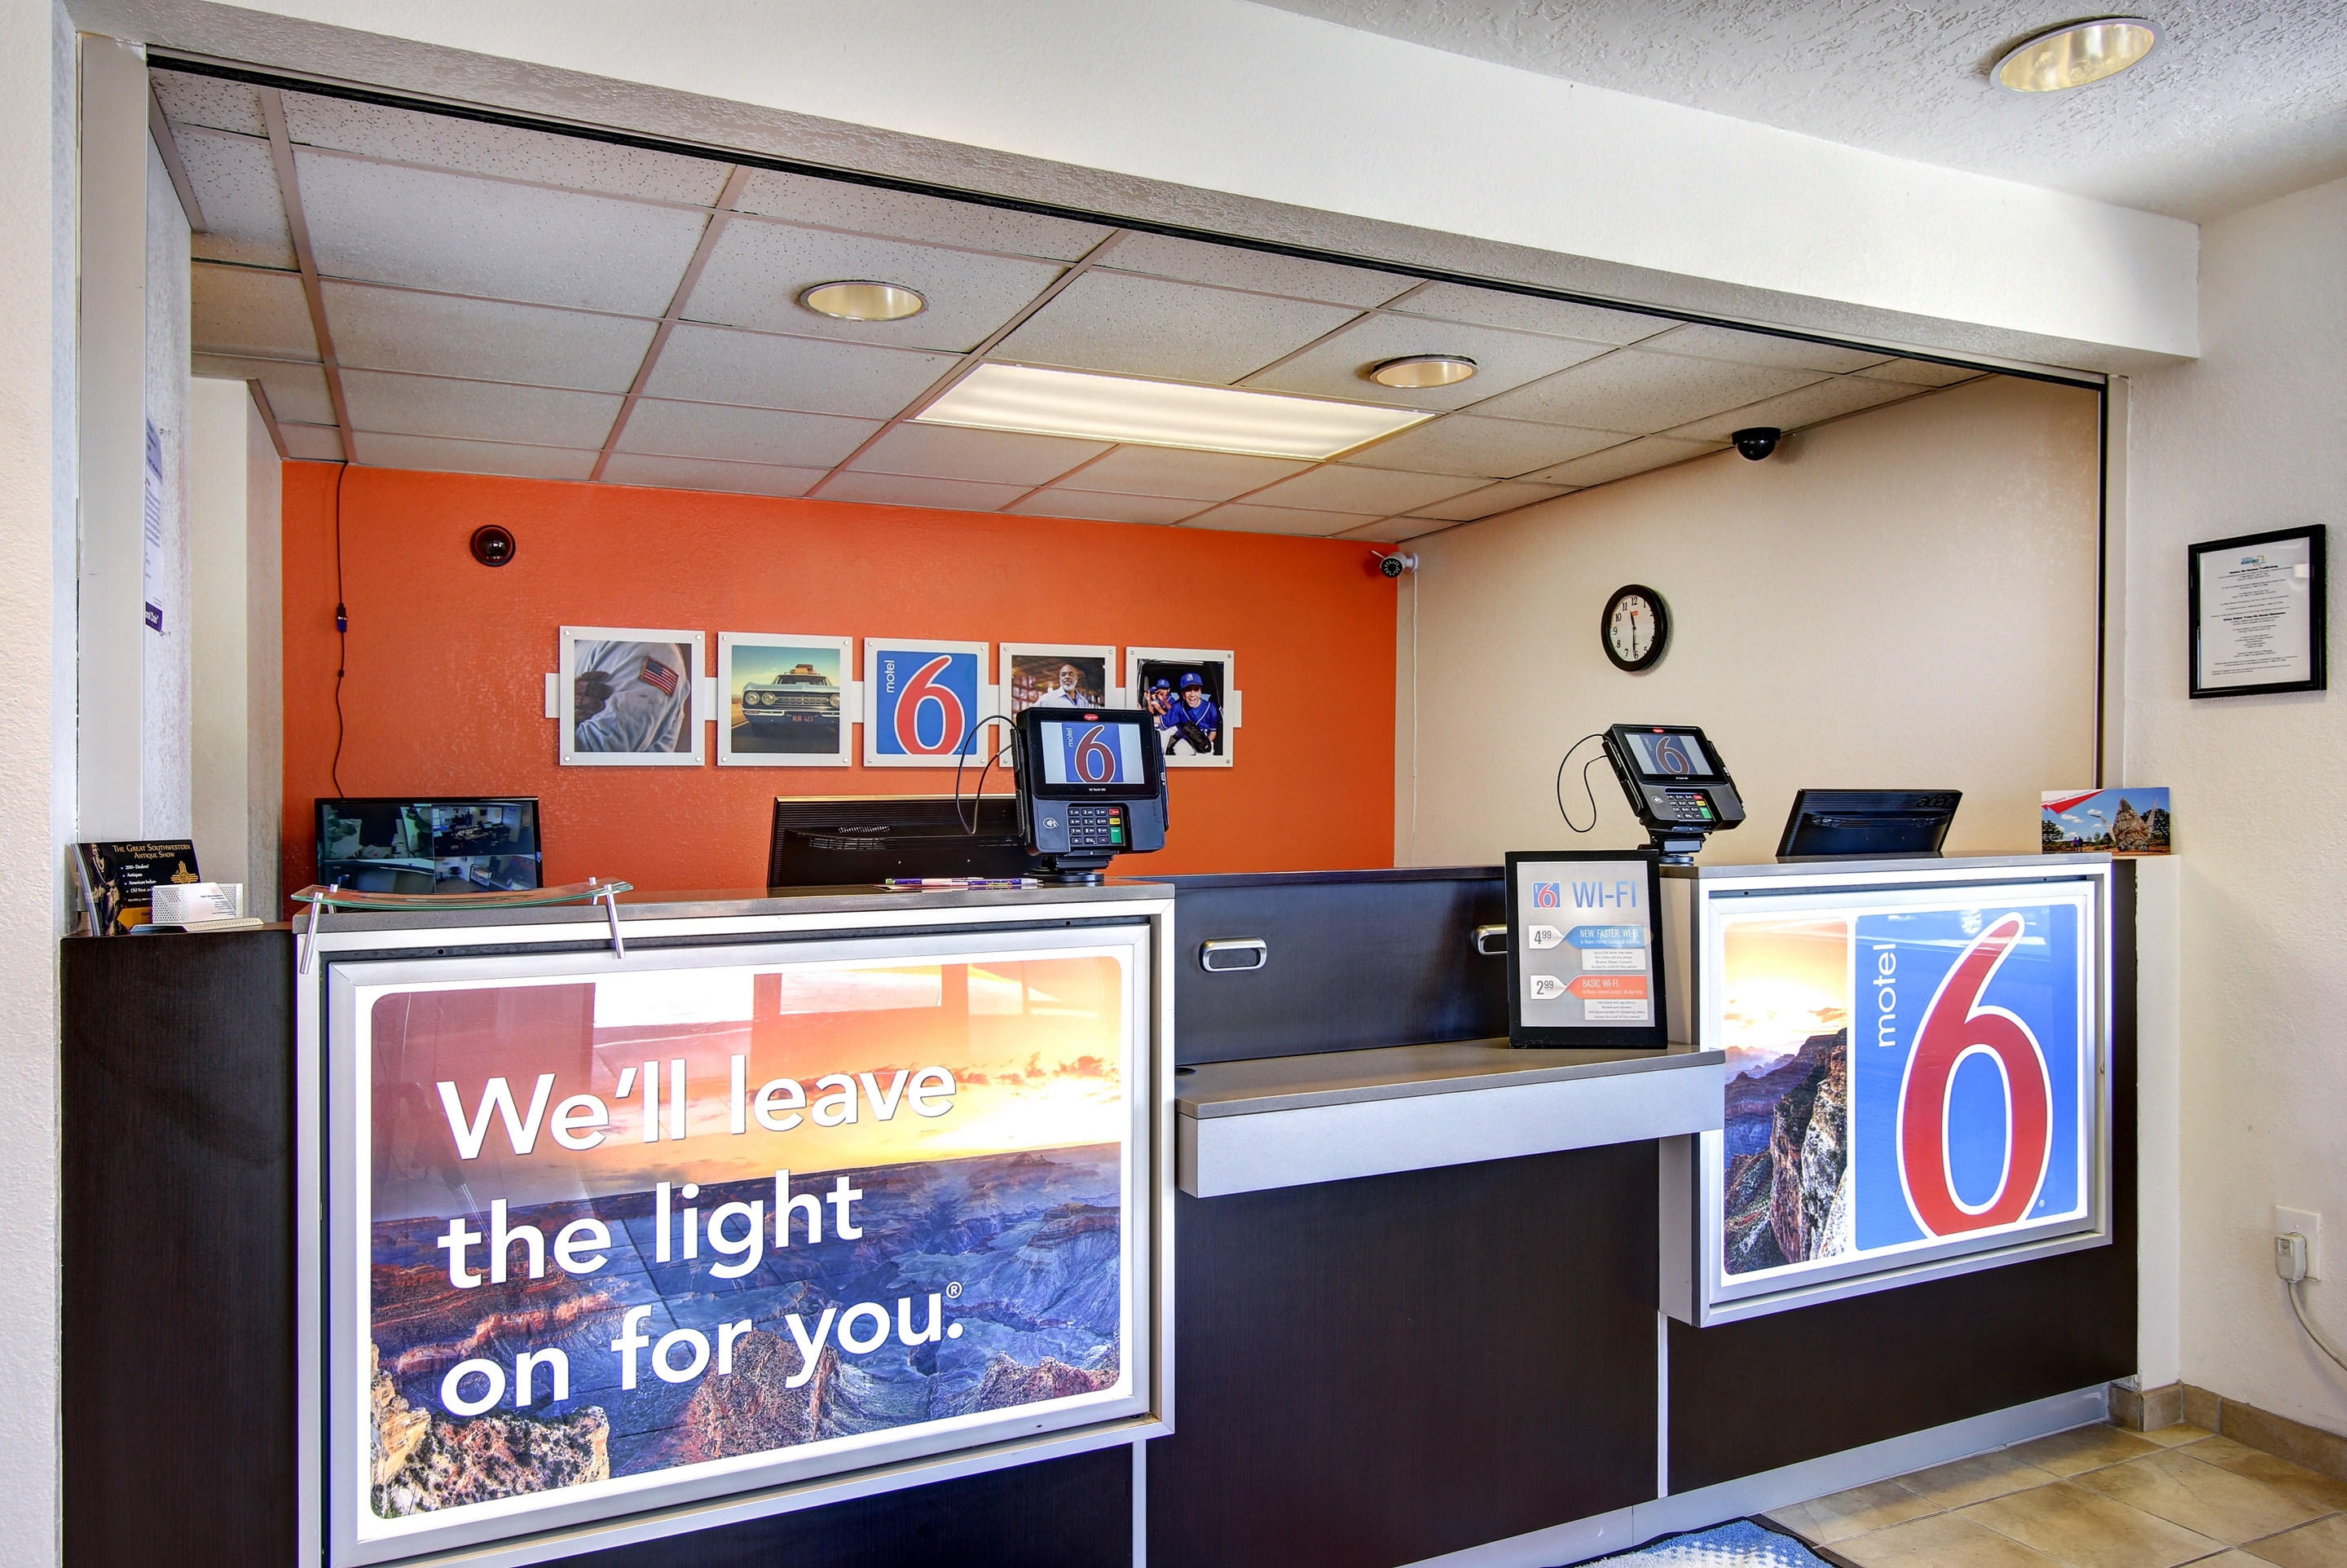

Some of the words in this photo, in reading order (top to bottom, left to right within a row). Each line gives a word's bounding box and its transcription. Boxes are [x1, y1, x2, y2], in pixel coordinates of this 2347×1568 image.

[1622, 601, 1627, 611] 11
[1631, 596, 1638, 606] 12
[1615, 612, 1622, 622] 10
[1613, 626, 1618, 636] 9
[1616, 639, 1621, 649] 8
[1624, 648, 1629, 658] 7
[1634, 650, 1639, 659] 6
[1643, 645, 1648, 655] 5
[884, 659, 895, 693] motel
[894, 654, 965, 755] 6
[1066, 728, 1074, 747] motel
[1075, 725, 1116, 782] 6
[1643, 738, 1653, 751] motel
[1656, 736, 1689, 774] 6
[2048, 796, 2067, 804] Origami
[112, 844, 125, 852] THE
[126, 844, 147, 852] GREAT
[147, 843, 192, 852] SOUTHWESTERN
[134, 852, 158, 860] ANTIQUE
[1538, 882, 1557, 909] 6
[1571, 881, 1636, 908] WI-FI
[1580, 929, 1596, 938] NEW.
[1597, 929, 1621, 938] FASTER.
[1622, 929, 1640, 938] WI-FI.
[1583, 980, 1601, 988] BASIC
[1602, 980, 1620, 988] WI-FI.
[1873, 944, 1896, 1048] motel
[1896, 911, 2054, 1240] 6
[436, 1058, 686, 1161] We'll
[731, 1054, 956, 1135] leave
[437, 1198, 611, 1289] the
[655, 1169, 864, 1280] light
[440, 1346, 569, 1417] on
[610, 1304, 752, 1391] for
